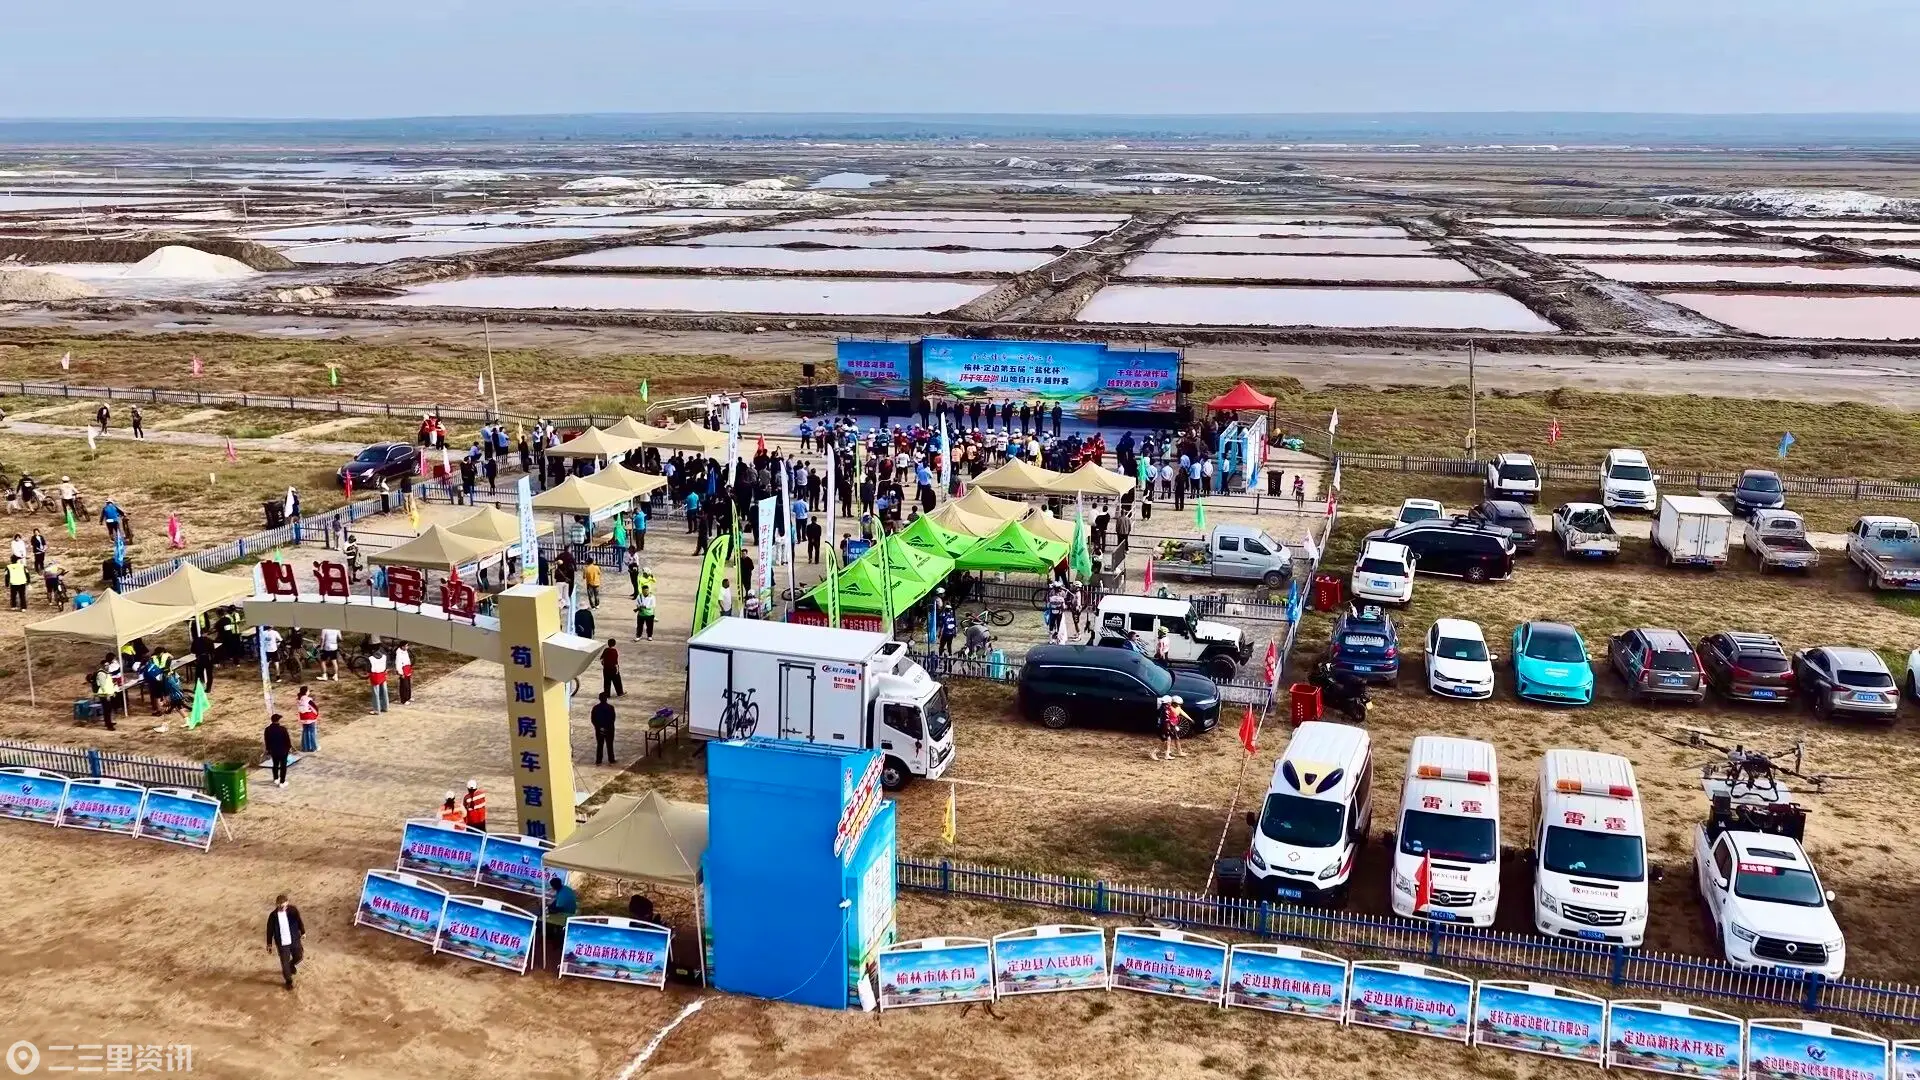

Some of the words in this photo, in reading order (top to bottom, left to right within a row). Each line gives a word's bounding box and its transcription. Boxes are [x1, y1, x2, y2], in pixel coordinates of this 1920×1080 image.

[1000, 375, 1069, 385] 山地自行车越野赛
[510, 645, 547, 840] 苟池房车营地
[1564, 811, 1627, 831] 雷霆
[409, 842, 472, 863] 定边县教育和体育局
[371, 895, 431, 923] 榆林市体育局
[448, 921, 521, 949] 定边县人民政府
[574, 943, 654, 964] 定边高新技术开发区
[1007, 954, 1096, 972] 定边县人民政府
[896, 968, 976, 985] 榆林市体育局
[1125, 957, 1213, 980] 陕西省自行车运动协会
[1242, 972, 1332, 998] 定边县教育和体育局
[1363, 989, 1457, 1018] 定边县体育运动中心
[1489, 1009, 1590, 1038] 延长石油定边盐化工有限公司
[1623, 1030, 1726, 1058] 定边高新技术开发区
